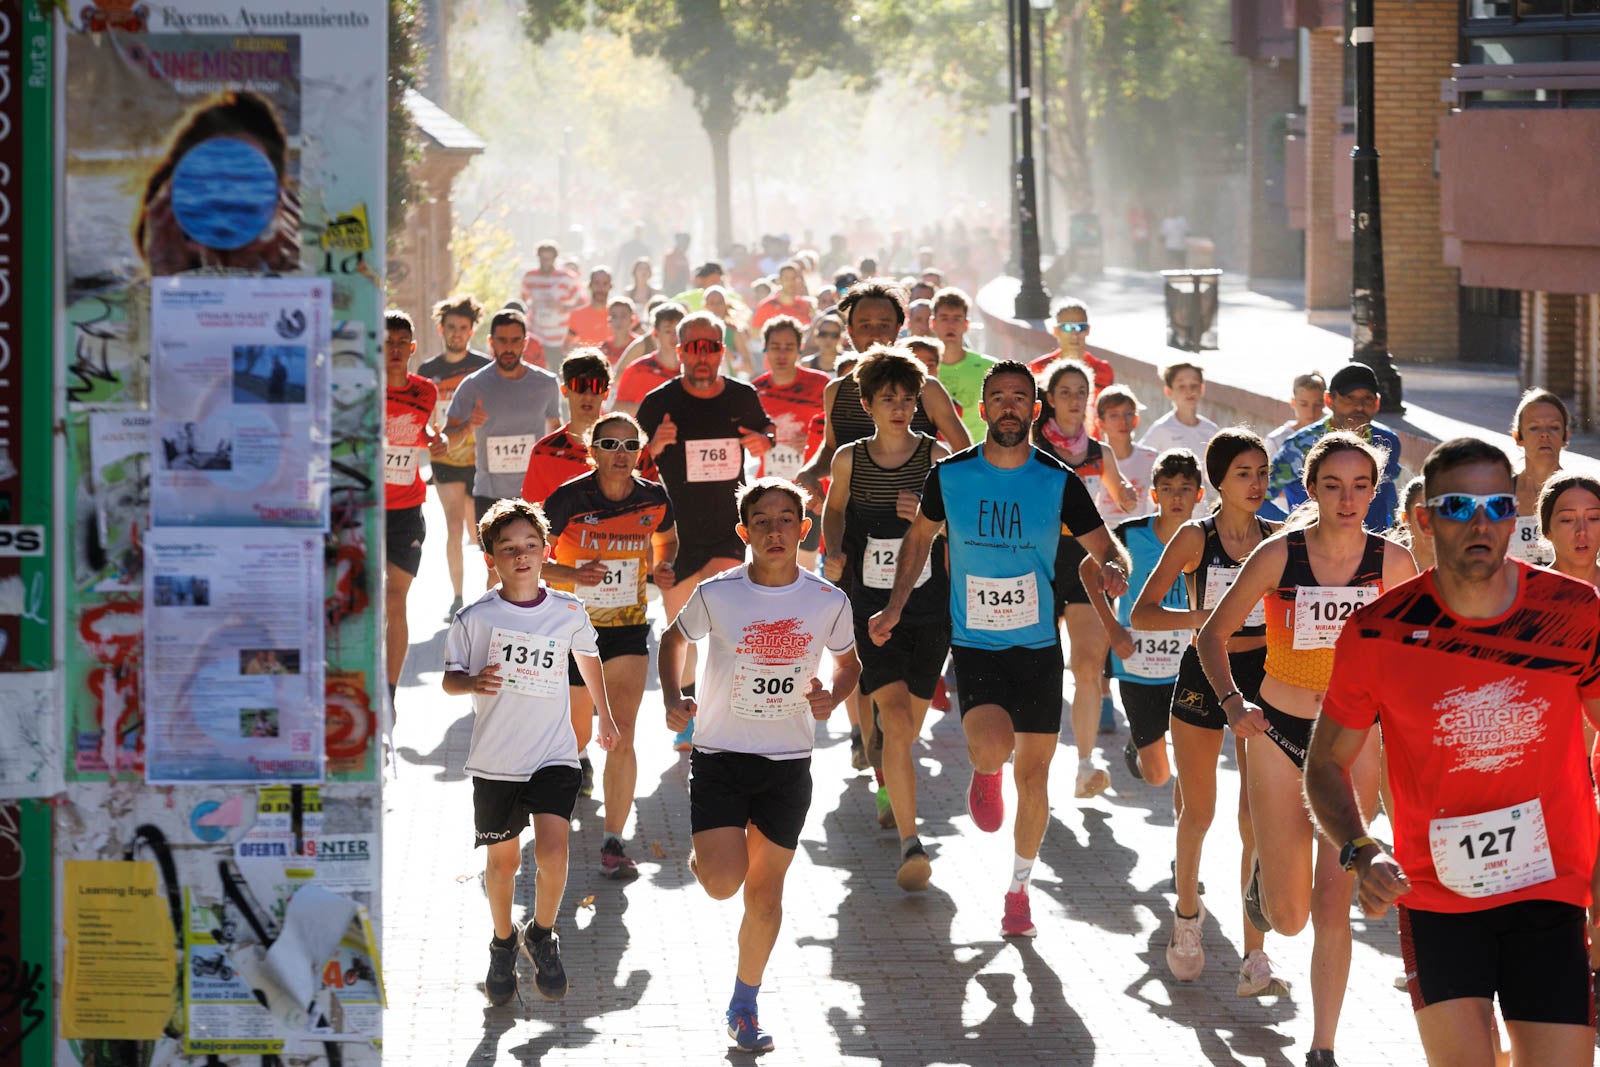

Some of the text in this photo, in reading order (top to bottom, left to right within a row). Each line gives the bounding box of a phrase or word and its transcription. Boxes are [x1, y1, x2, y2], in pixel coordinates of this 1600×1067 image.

[237, 7, 369, 32] Ayuntamiento
[28, 35, 47, 88] Ruta
[494, 444, 526, 456] 1147
[700, 448, 727, 462] 768
[772, 453, 800, 464] 1411
[978, 500, 1022, 539] ENA
[590, 531, 645, 541] Club Deportivo
[977, 589, 1025, 606] 1343
[745, 634, 807, 647] carrera
[1134, 639, 1180, 655] 1342
[502, 644, 554, 669] 1315
[744, 647, 805, 657] cruzroja.es
[752, 677, 794, 694] 306
[1440, 706, 1539, 729] carrera
[1266, 725, 1279, 741] LA
[1444, 728, 1538, 746] cruzroja.es
[240, 842, 286, 856] OFERTA
[1459, 826, 1516, 860] 127
[1484, 859, 1508, 871] JIMMY
[78, 886, 126, 898] Learning
[190, 1041, 268, 1052] Mejoramos
